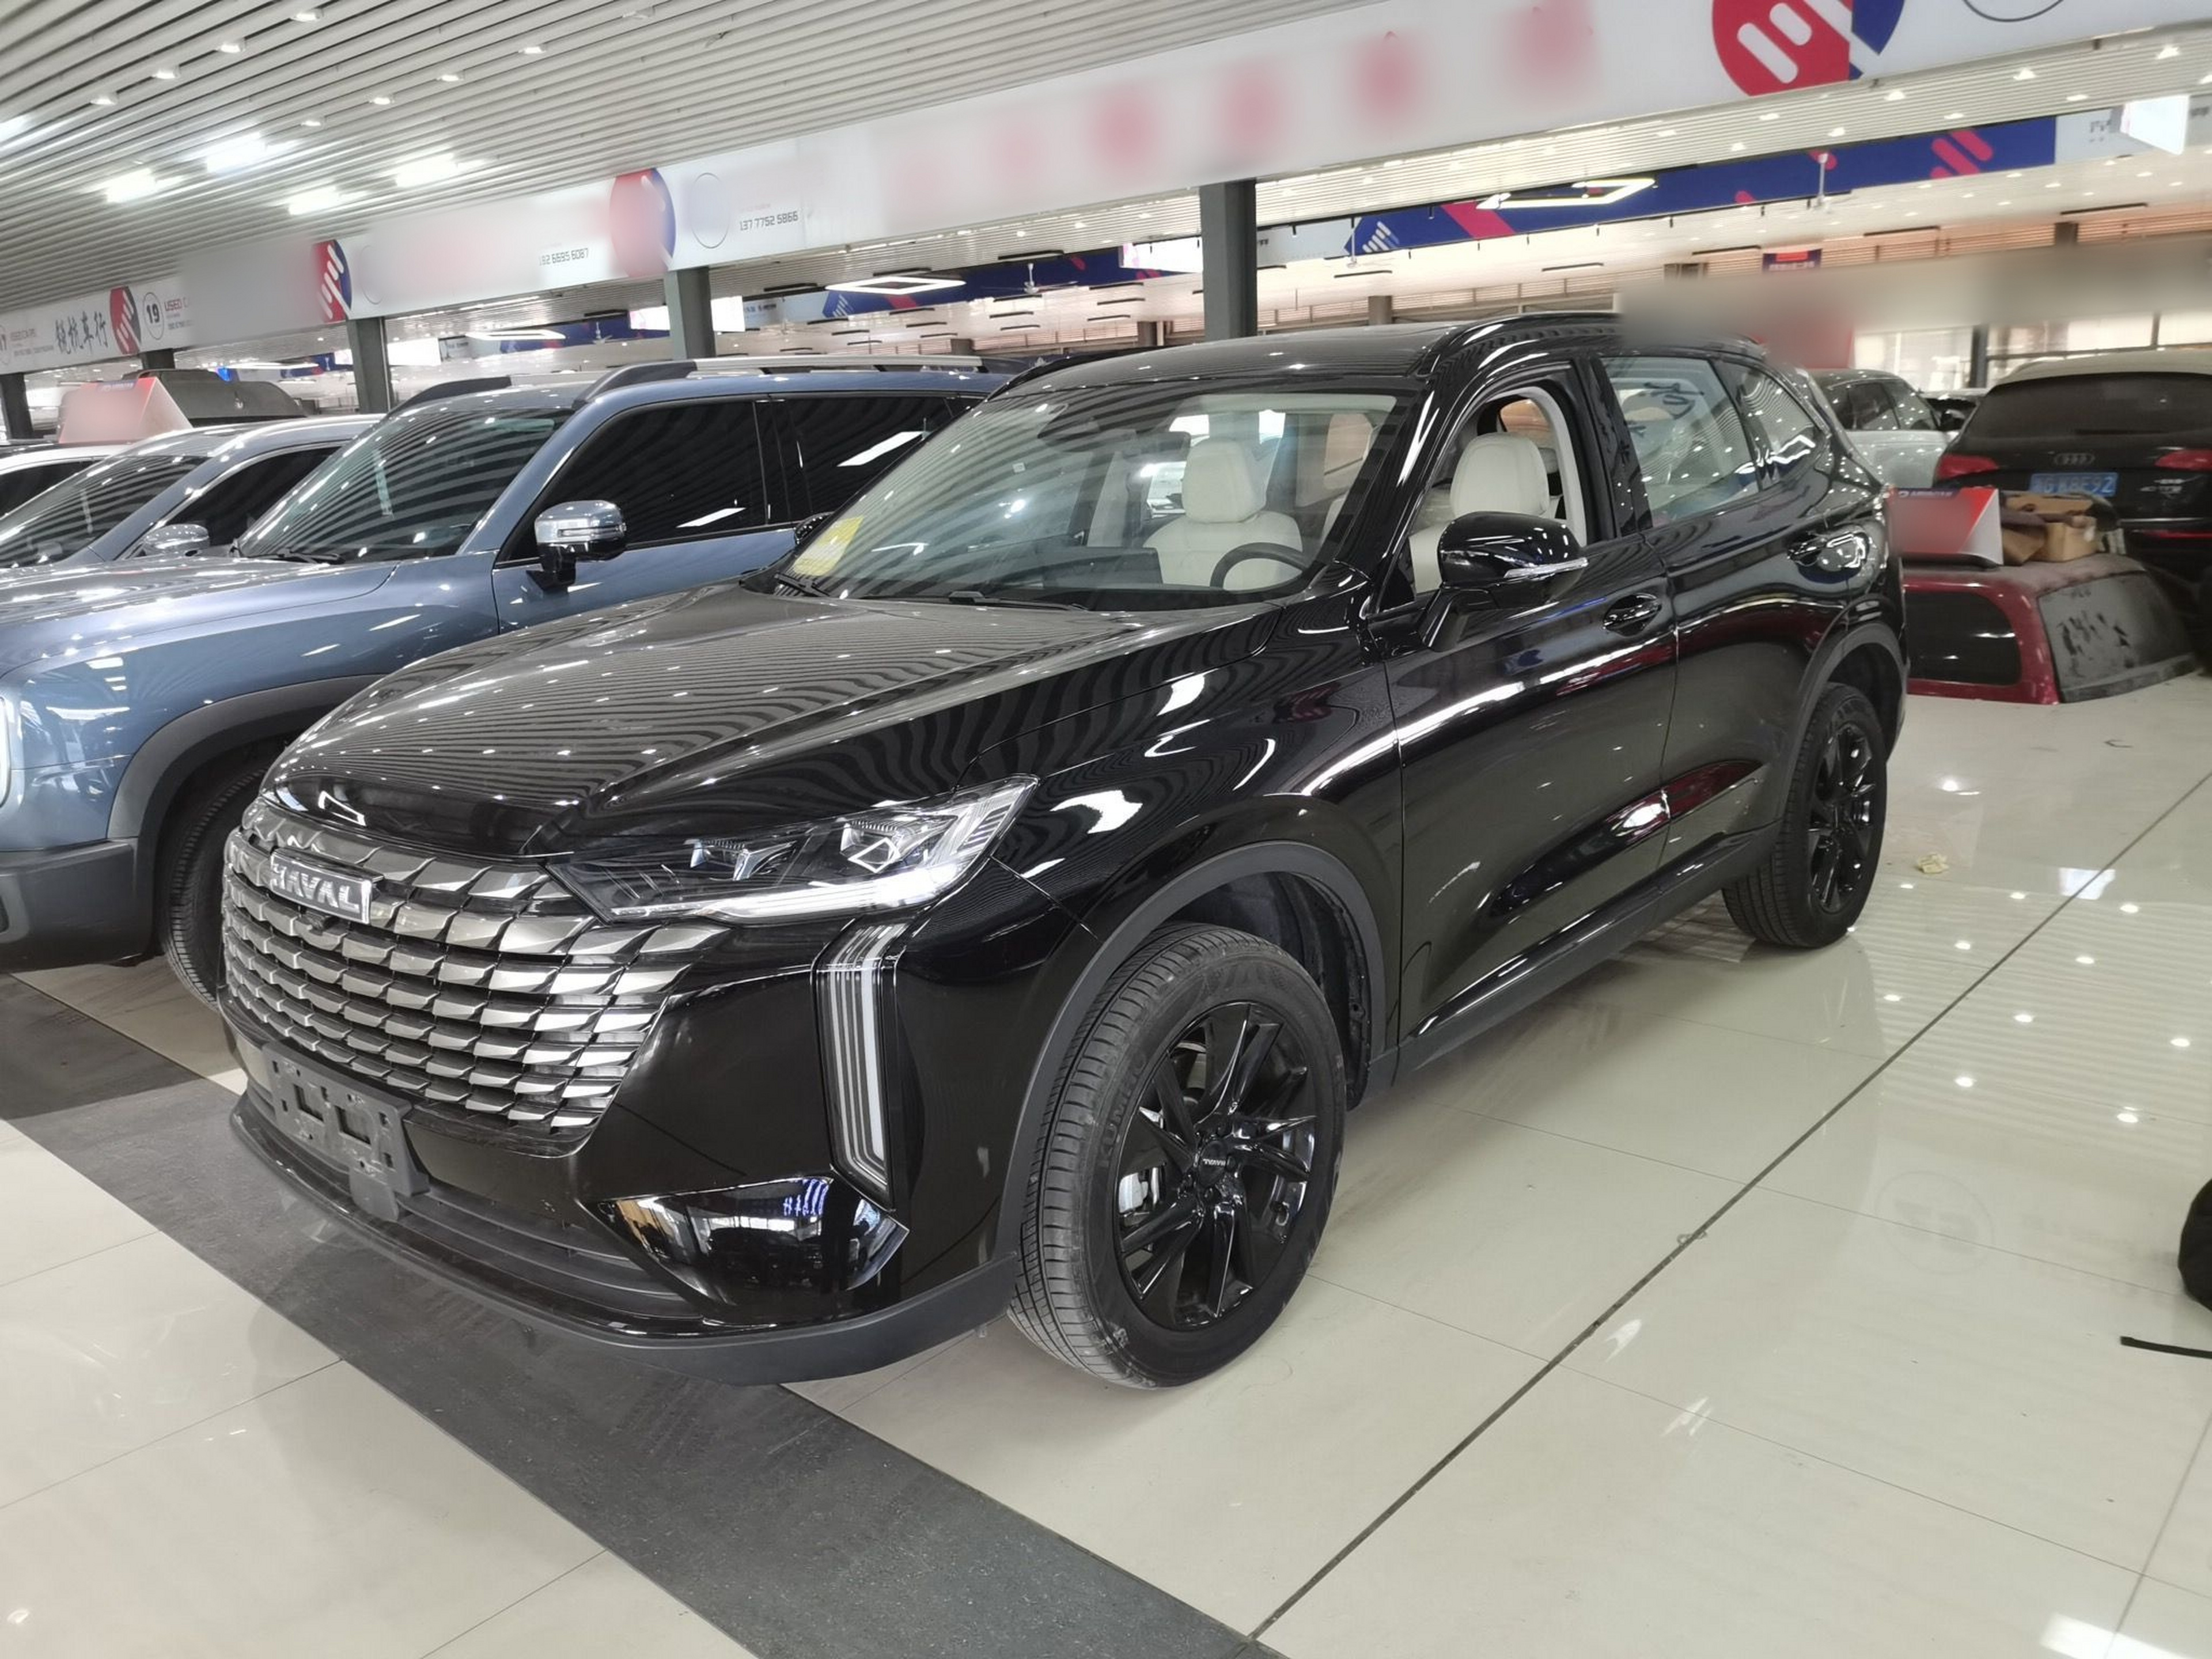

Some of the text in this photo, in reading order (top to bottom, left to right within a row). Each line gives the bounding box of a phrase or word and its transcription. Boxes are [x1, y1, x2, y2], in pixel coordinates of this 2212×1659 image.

[740, 220, 752, 231] 137
[146, 303, 160, 324] 19
[270, 863, 361, 914] HAVAL
